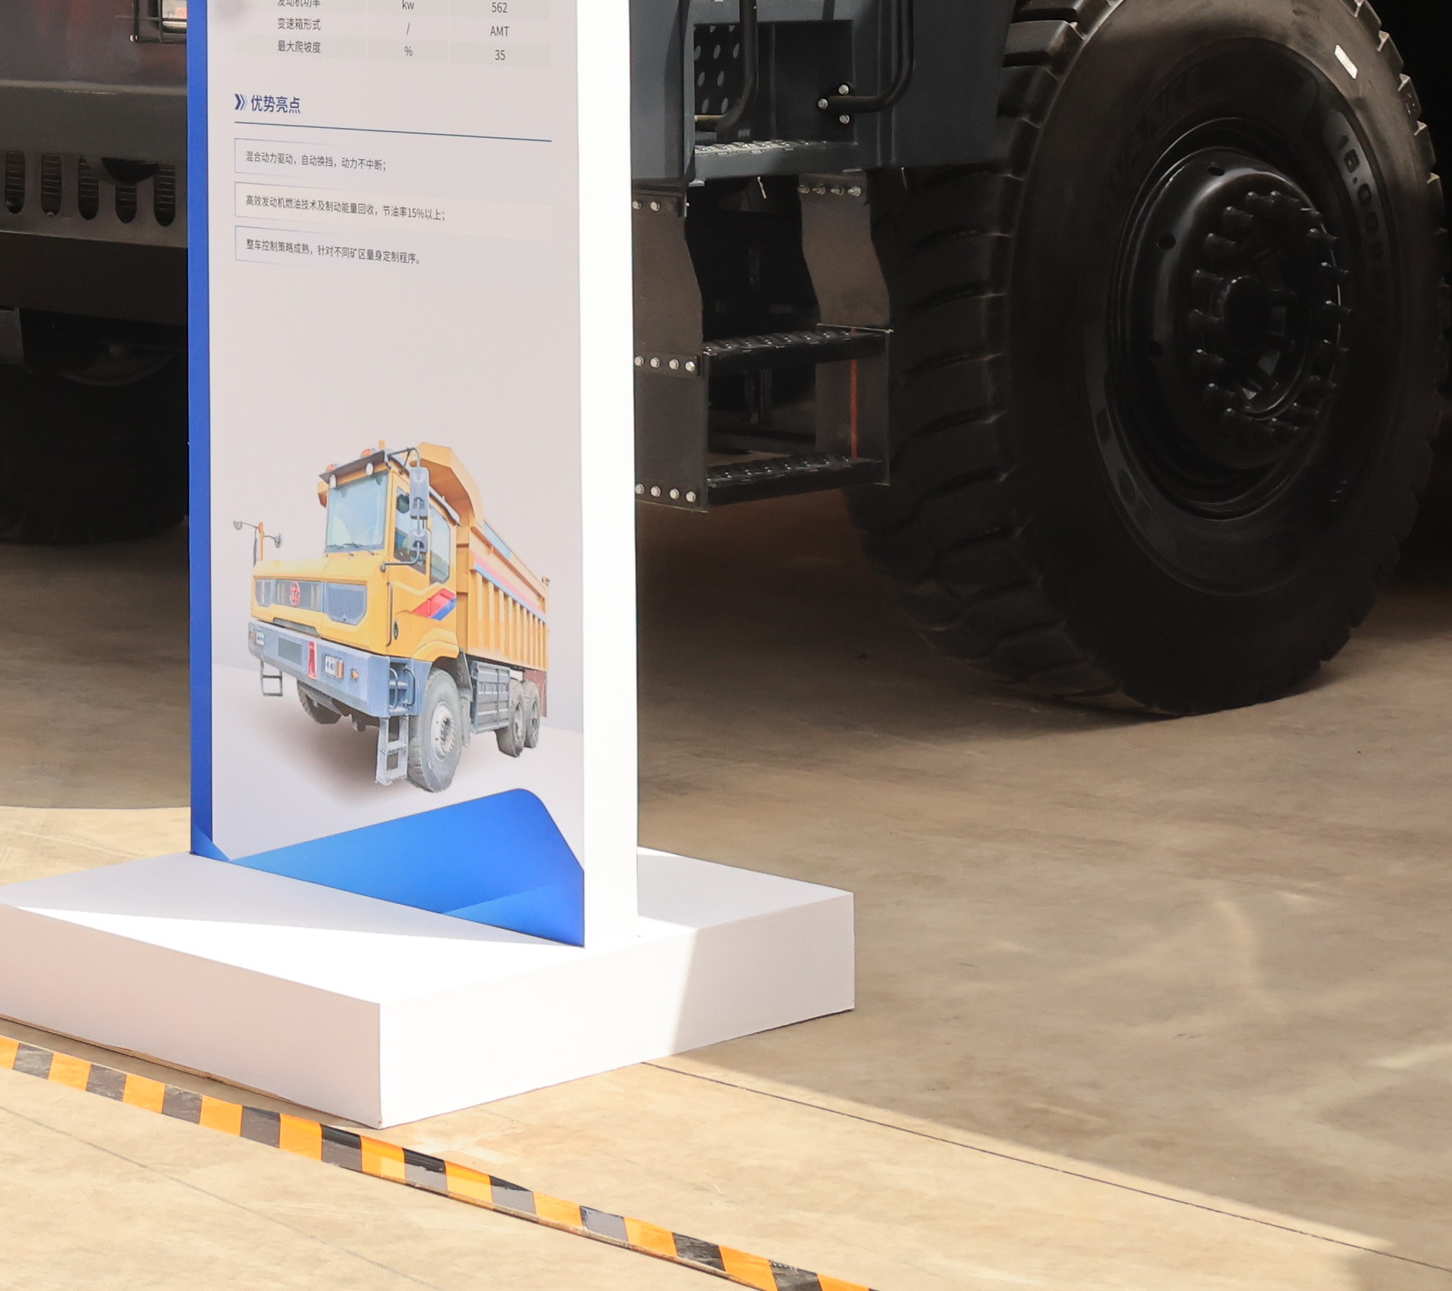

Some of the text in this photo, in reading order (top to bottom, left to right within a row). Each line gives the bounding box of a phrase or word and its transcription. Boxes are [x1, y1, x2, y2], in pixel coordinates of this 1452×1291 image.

[401, 0, 415, 11] kw
[491, 1, 508, 14] 562
[277, 17, 321, 32] 变速箱形式
[490, 25, 510, 38] AMT
[277, 40, 506, 62] 最大爬坡度 % 35
[250, 95, 301, 115] 优势亮点
